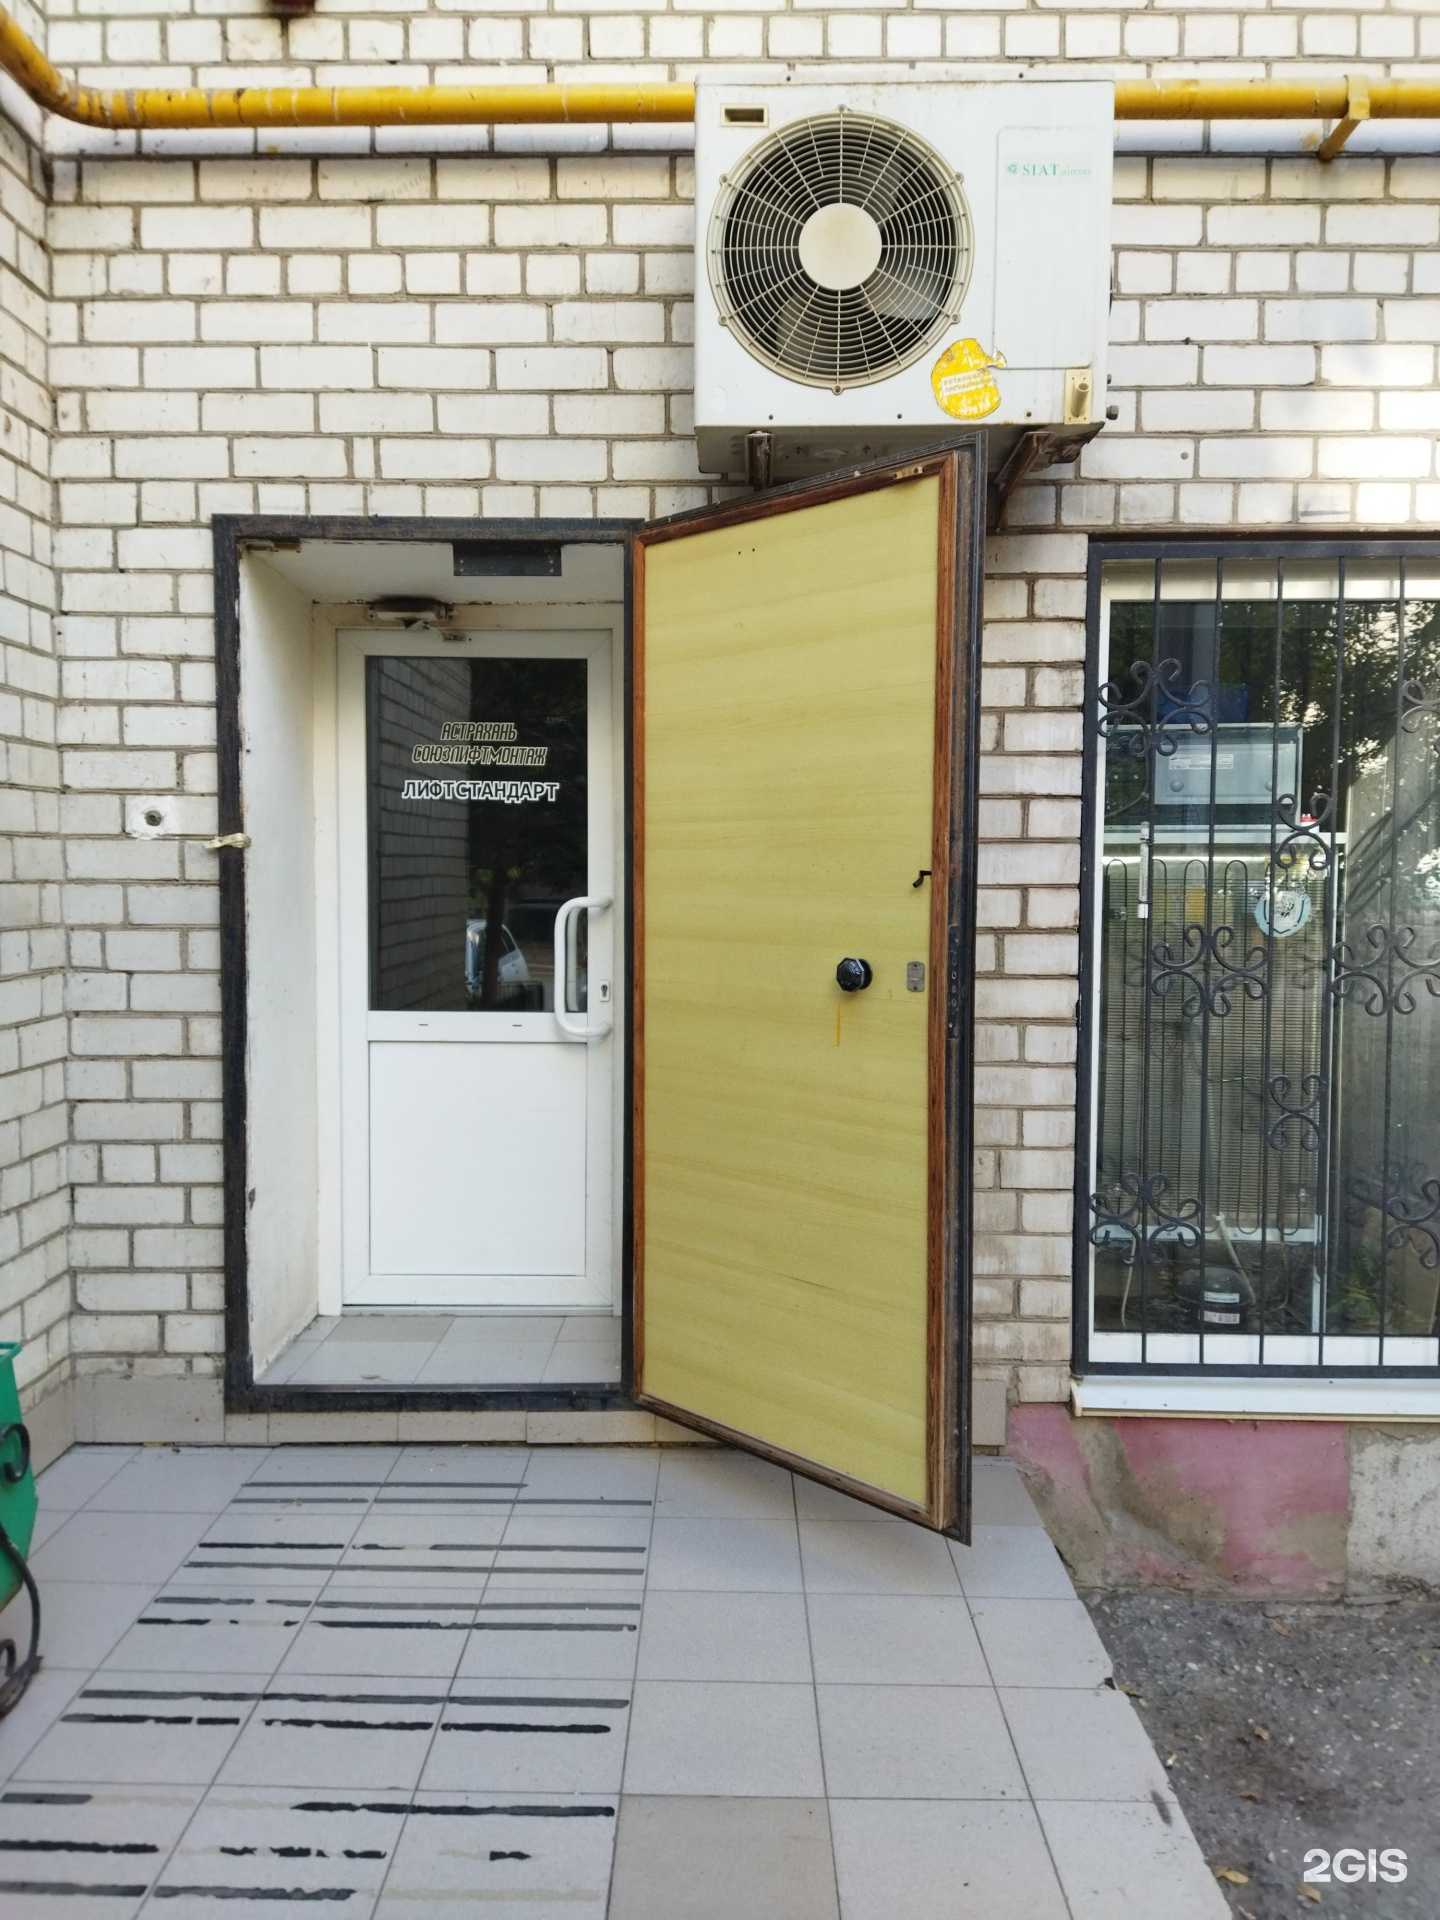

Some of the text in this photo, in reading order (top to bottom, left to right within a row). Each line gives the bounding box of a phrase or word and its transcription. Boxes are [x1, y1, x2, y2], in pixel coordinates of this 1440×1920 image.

[440, 721, 518, 742] АСТРАХАНЬ
[412, 744, 548, 766] СОЮЗЛИФТМОНТАЖ
[402, 779, 560, 804] ЛИФТСТАНДАРТ
